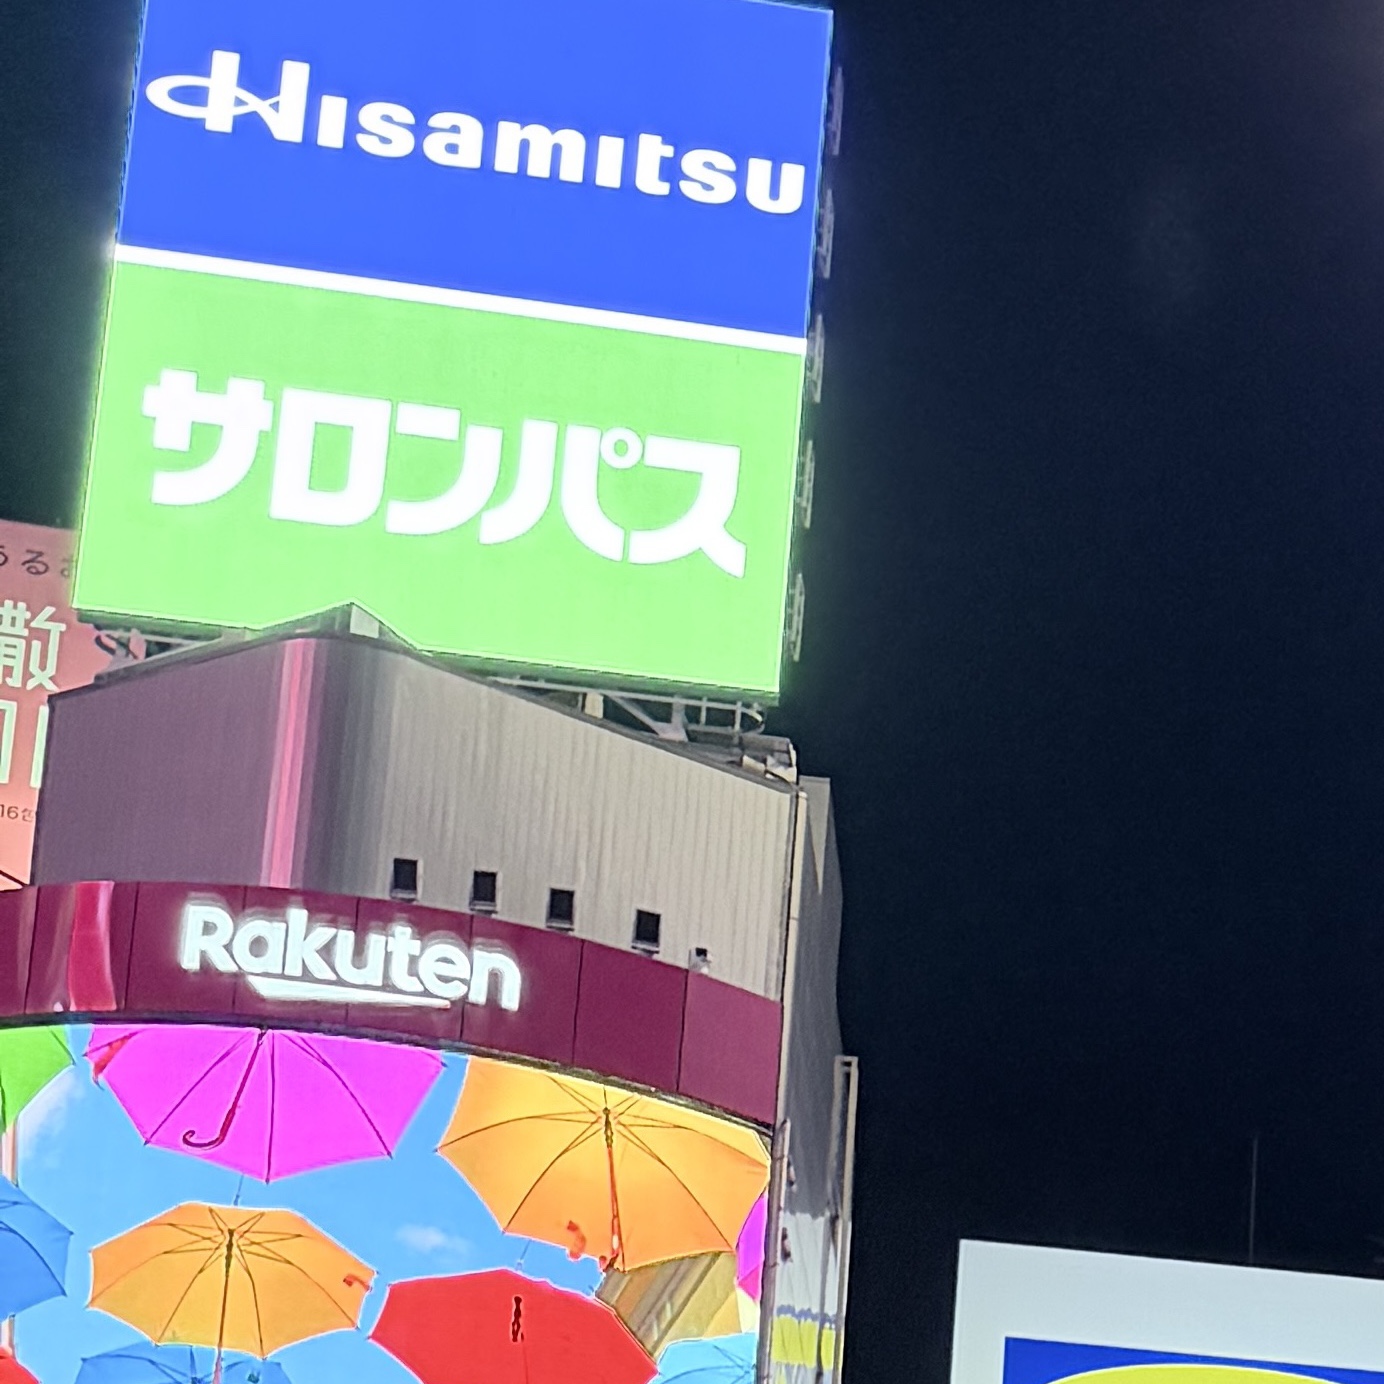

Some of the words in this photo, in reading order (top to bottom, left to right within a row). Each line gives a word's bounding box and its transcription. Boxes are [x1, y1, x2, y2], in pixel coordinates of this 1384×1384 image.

[146, 50, 805, 214] Hisamitsu
[142, 369, 746, 579] サロンパス
[180, 901, 521, 1011] Rakuten
